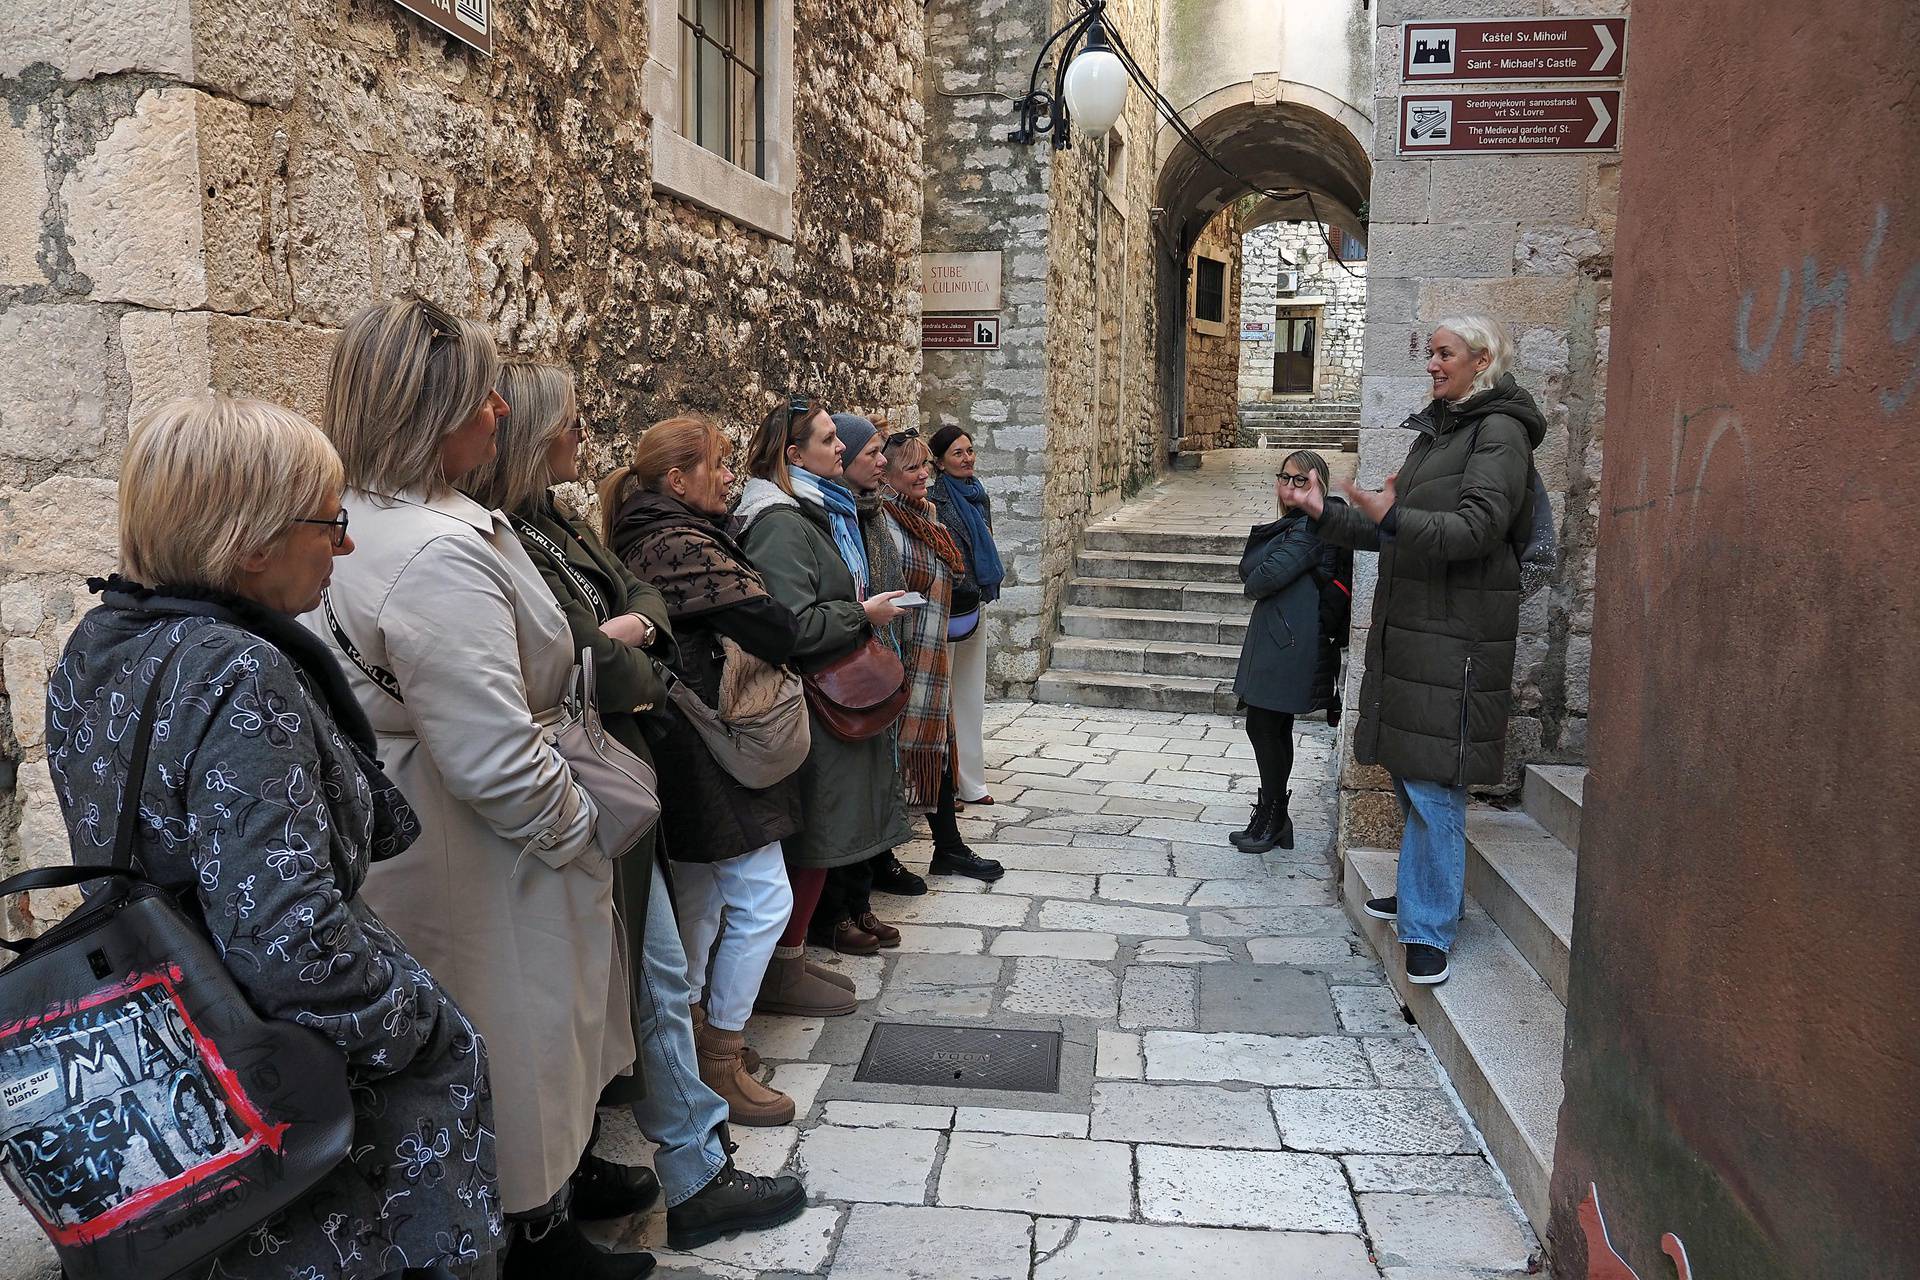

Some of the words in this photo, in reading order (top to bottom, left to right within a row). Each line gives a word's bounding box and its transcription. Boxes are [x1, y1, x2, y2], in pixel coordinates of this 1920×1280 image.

[1482, 32, 1513, 42] Kaštel
[1517, 32, 1531, 42] Sv.
[1533, 31, 1567, 41] Mihovil
[1467, 59, 1492, 69] Saint
[1500, 58, 1544, 69] Michael's
[1546, 58, 1577, 68] Castle
[1466, 99, 1526, 109] Srednjovjekovni
[1529, 98, 1577, 106] samostanski
[1494, 109, 1507, 117] vrt
[1523, 108, 1545, 116] Lovre
[1468, 126, 1483, 134] The
[1485, 126, 1519, 134] Medieval
[1520, 126, 1547, 135] garden
[1548, 125, 1557, 133] of
[1559, 124, 1571, 133] St.
[1479, 136, 1517, 144] Lowrence
[1518, 135, 1560, 144] Monastery
[931, 266, 962, 279] STUBE
[520, 525, 550, 549] KARL
[347, 646, 380, 681] KARL
[3, 1081, 27, 1098] Noir
[30, 1071, 49, 1086] sur
[6, 1087, 40, 1107] blanc
